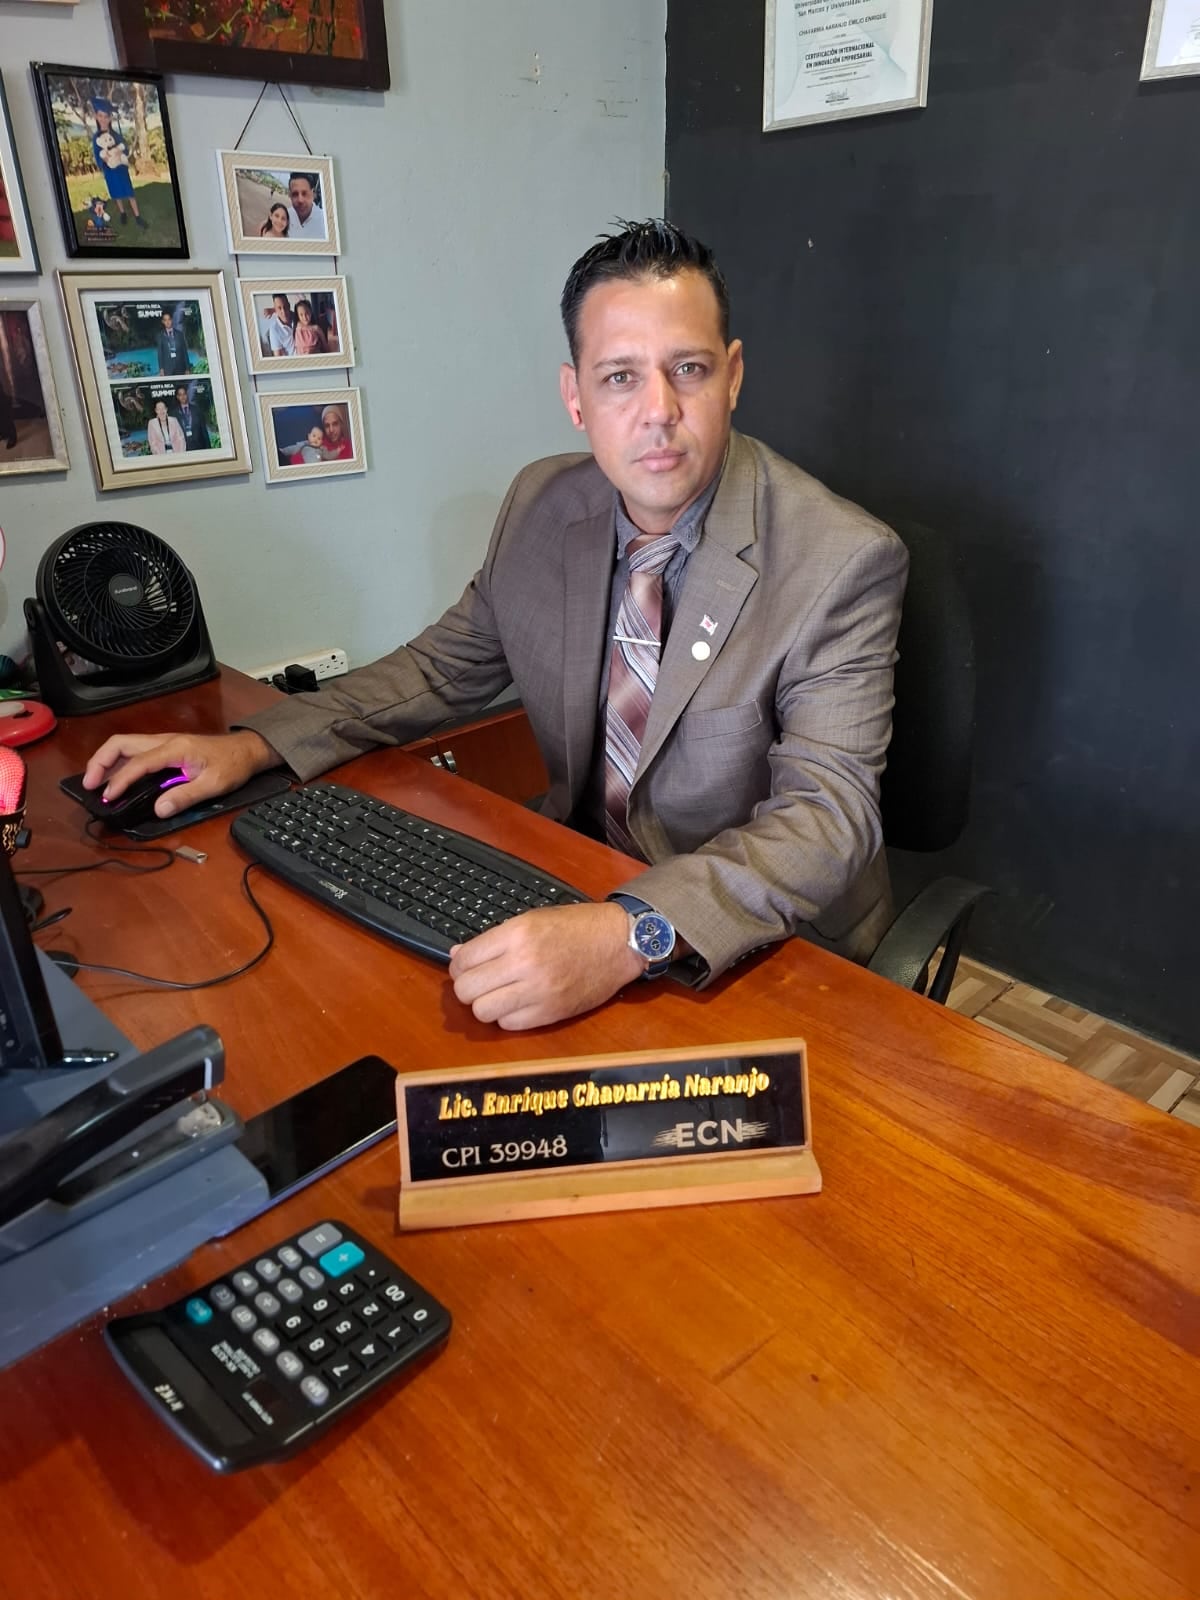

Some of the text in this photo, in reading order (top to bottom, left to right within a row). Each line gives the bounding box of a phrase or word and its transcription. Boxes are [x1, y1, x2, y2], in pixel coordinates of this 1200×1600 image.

[807, 6, 825, 15] Marcos
[825, 21, 848, 31] NARANJO
[864, 12, 888, 22] ENRIQUE
[838, 41, 875, 54] INTERNACIONAL
[841, 51, 873, 63] EMPRESARIAL
[137, 310, 163, 318] SUMMIT
[151, 389, 176, 398] SUMMIT
[438, 1092, 478, 1120] Lic.
[481, 1086, 569, 1116] Enrique
[684, 1067, 770, 1098] Naranjo
[675, 1118, 745, 1148] ECN
[442, 1136, 568, 1168] CPI 39948
[340, 1283, 354, 1295] 3
[385, 1285, 405, 1301] 00
[313, 1299, 328, 1311] 6
[363, 1302, 379, 1316] 2
[285, 1315, 301, 1328] 9
[413, 1309, 427, 1321] 0
[336, 1320, 351, 1333] 5
[388, 1326, 401, 1338] 1
[309, 1337, 325, 1351] 8
[361, 1343, 375, 1355] 4
[332, 1364, 349, 1377] 7
